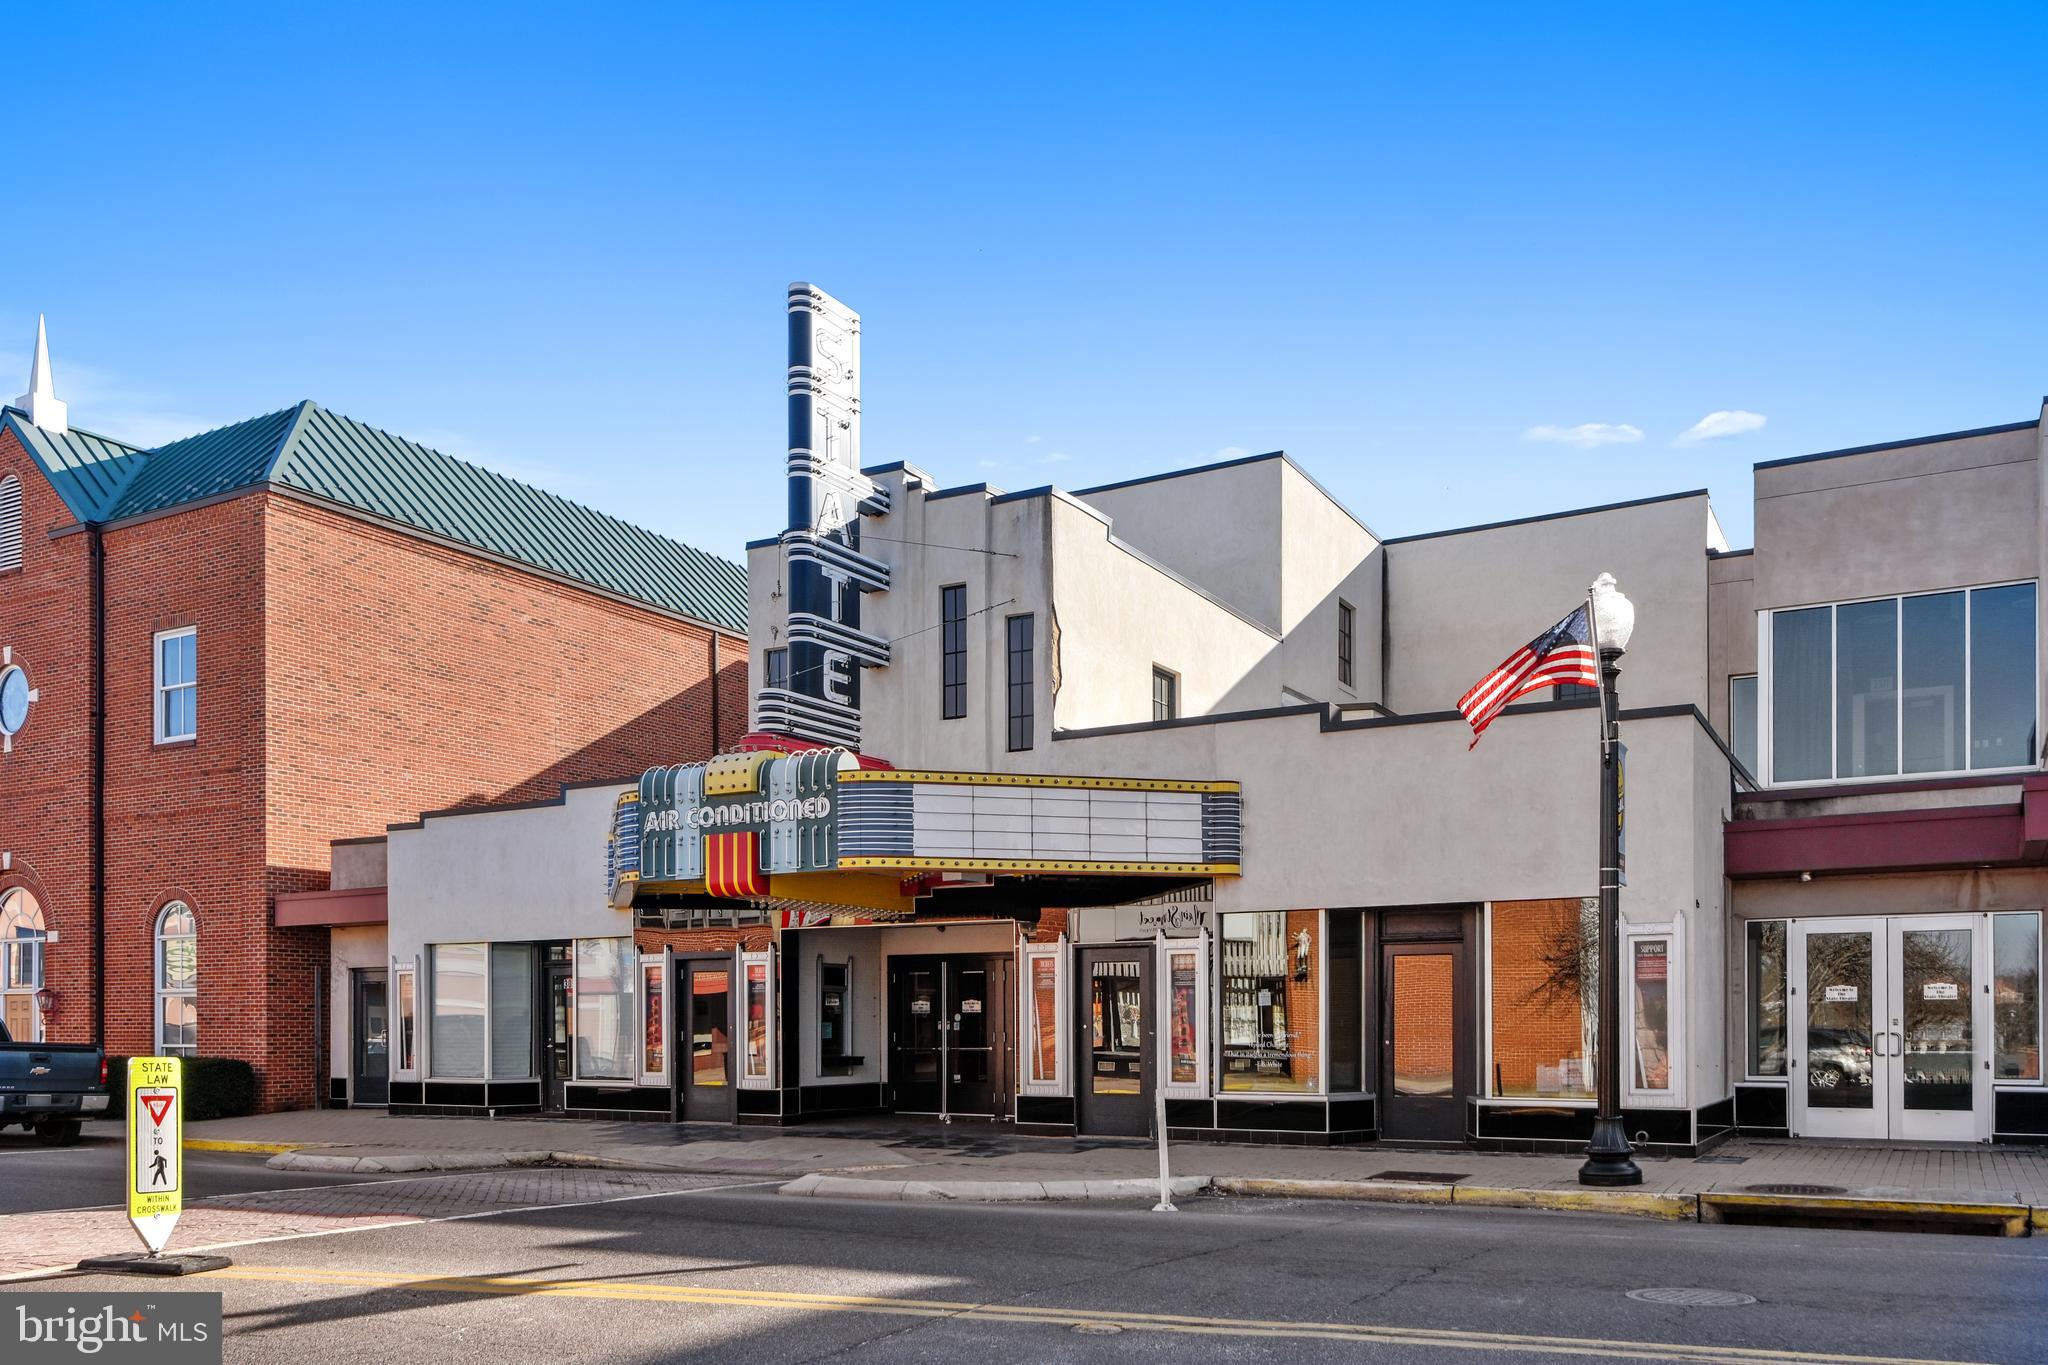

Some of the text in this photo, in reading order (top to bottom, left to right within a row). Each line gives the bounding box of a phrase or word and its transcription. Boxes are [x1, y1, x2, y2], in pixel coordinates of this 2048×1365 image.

[815, 326, 854, 706] STATE
[644, 793, 831, 832] AIR CONDITIONED
[1640, 944, 1664, 953] SUPPORT
[142, 1062, 173, 1072] STATE
[147, 1074, 168, 1084] LAW
[153, 1137, 163, 1145] TO
[147, 1195, 170, 1203] WITHIN
[136, 1204, 177, 1214] CROSSWALK
